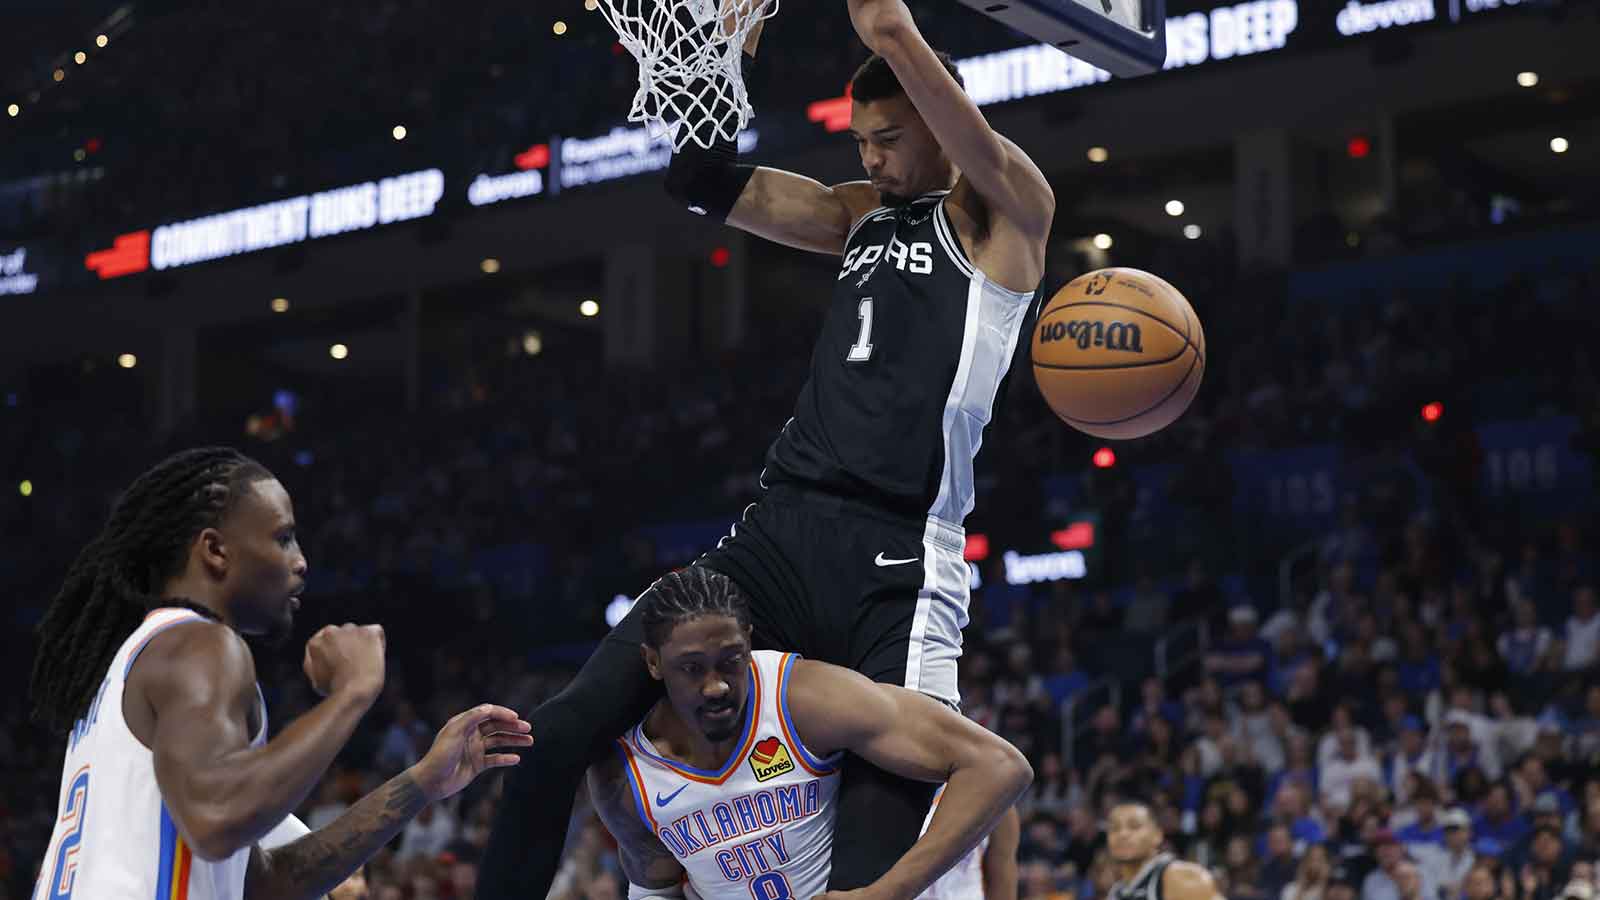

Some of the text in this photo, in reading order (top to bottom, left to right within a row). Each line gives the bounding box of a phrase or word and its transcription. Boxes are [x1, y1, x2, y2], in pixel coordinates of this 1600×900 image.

[1210, 0, 1298, 60] DEEP
[1336, 0, 1435, 35] devon
[468, 168, 543, 206] devon
[150, 168, 445, 270] COMMITMENT RUNS DEEP
[838, 232, 933, 280] SPRS
[846, 296, 874, 361] 1
[1040, 319, 1144, 353] Wilson
[657, 779, 821, 858] OKLAHOMA
[714, 830, 790, 882] CITY
